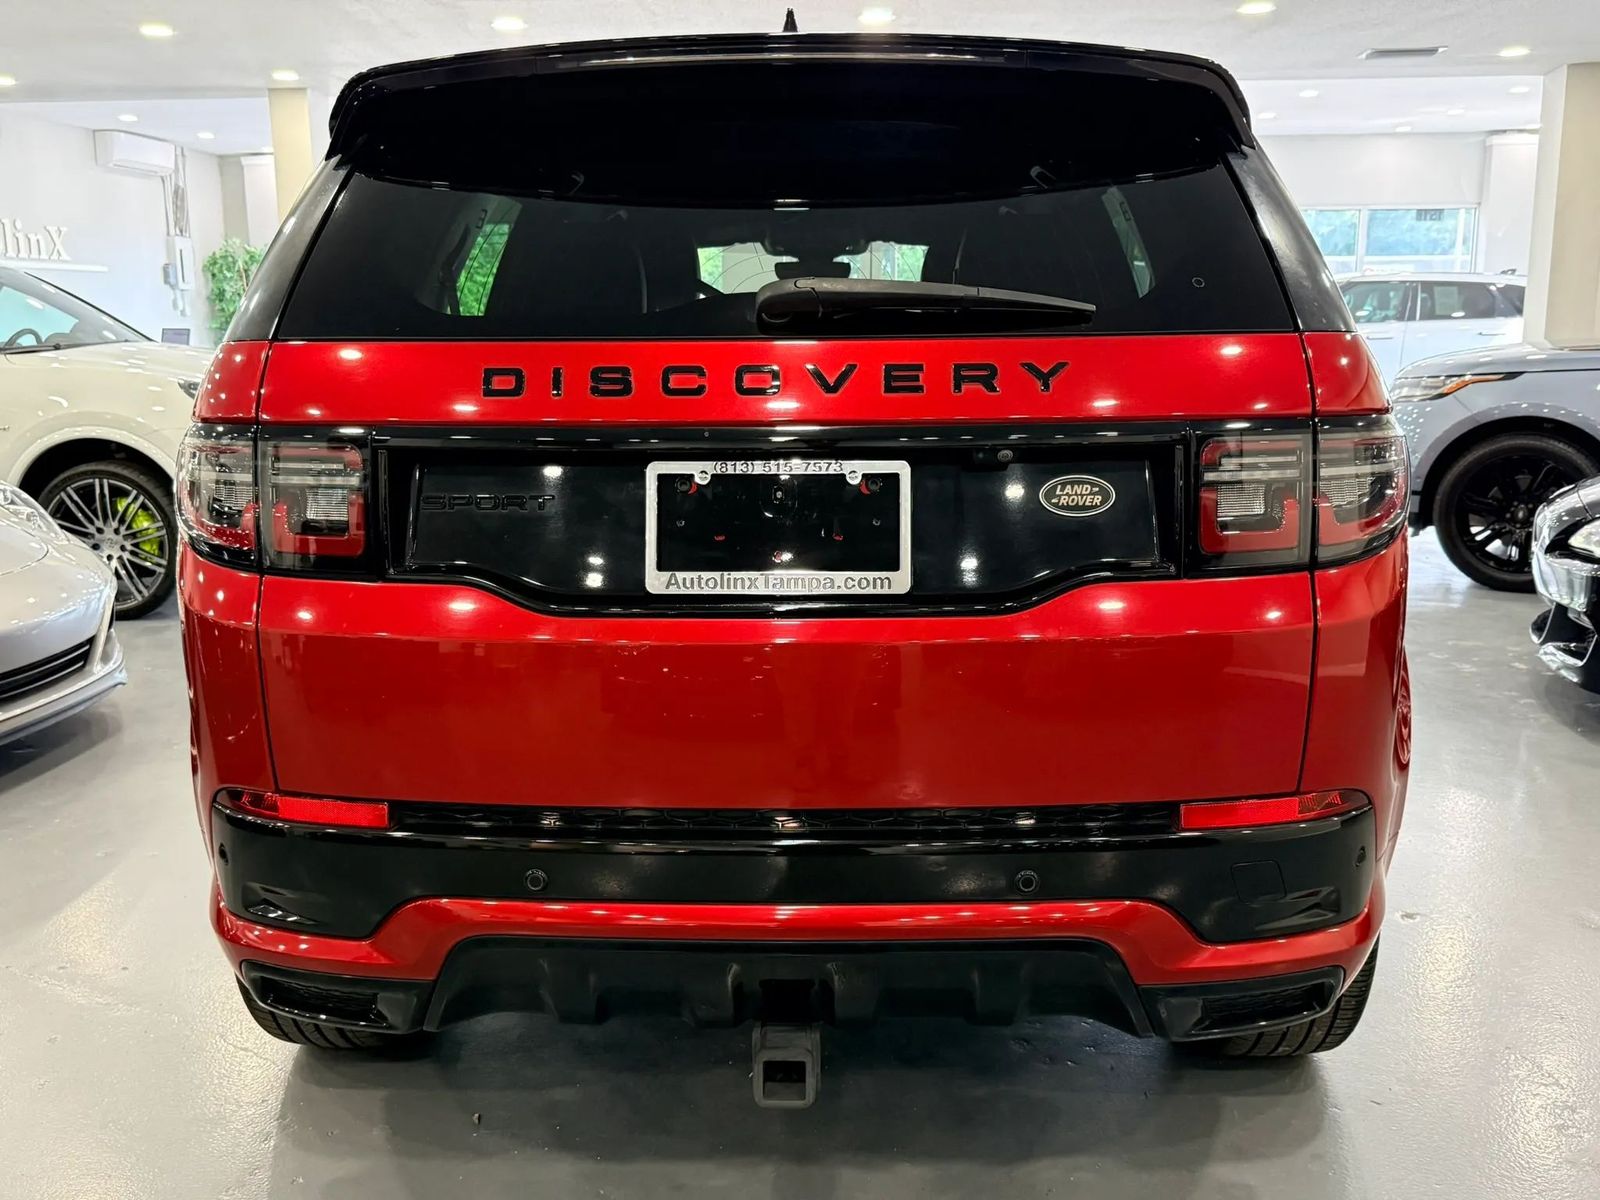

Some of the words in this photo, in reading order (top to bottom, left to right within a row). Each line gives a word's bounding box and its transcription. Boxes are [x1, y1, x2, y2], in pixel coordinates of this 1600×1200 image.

[481, 361, 1070, 398] DISCOVERY
[713, 460, 755, 474] (813)
[762, 460, 843, 473] 515-7573
[1055, 484, 1092, 495] LAND
[420, 494, 556, 511] SPORT
[1058, 495, 1102, 506] ROVER
[664, 572, 893, 592] AutolinxTampa.com
